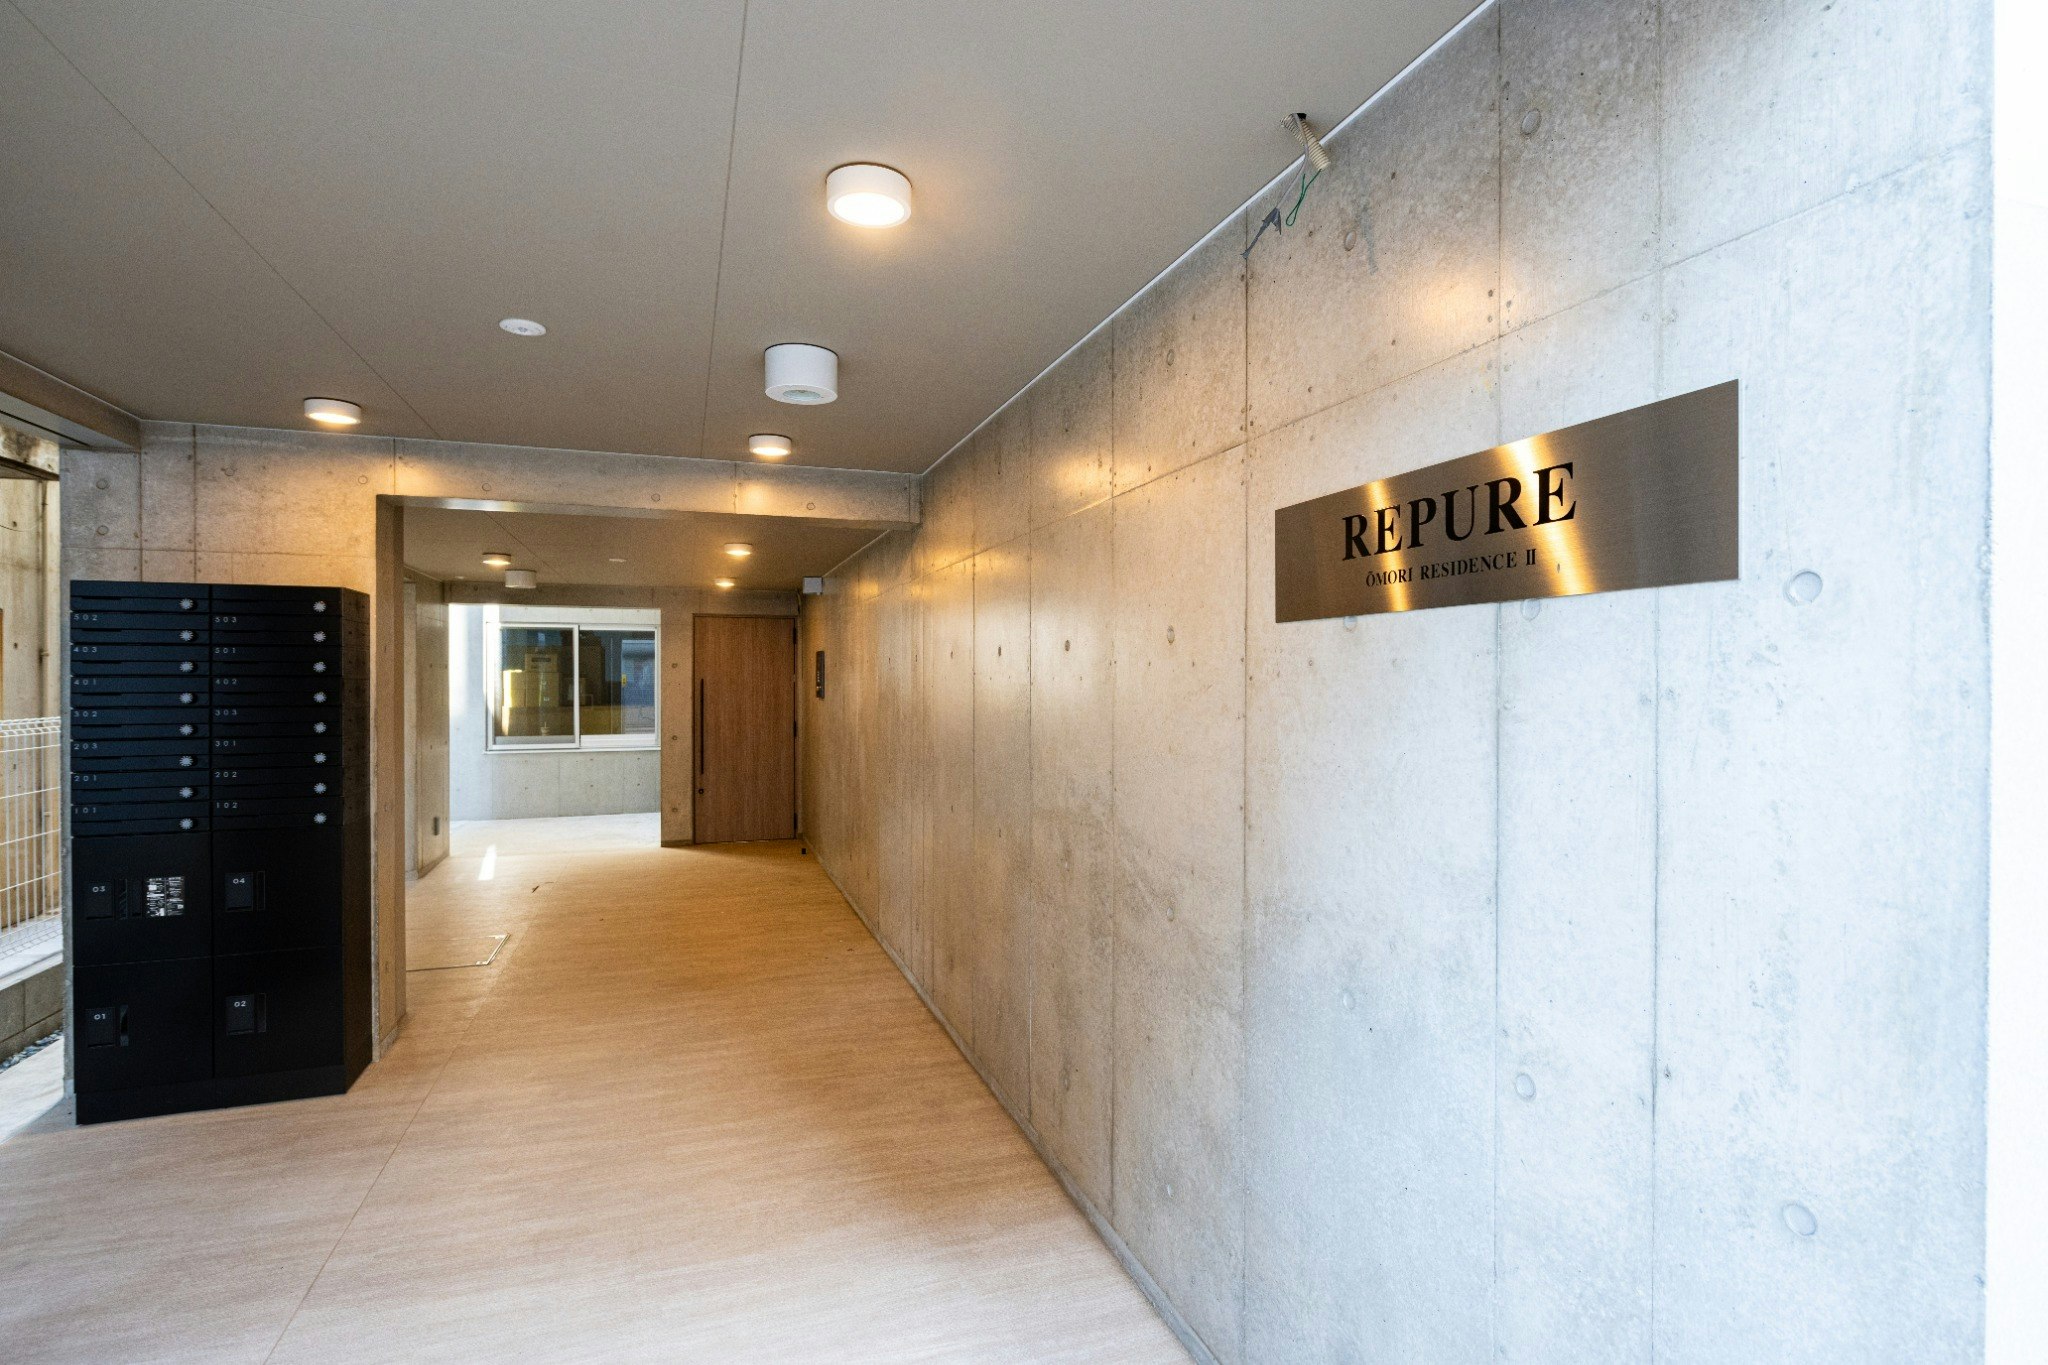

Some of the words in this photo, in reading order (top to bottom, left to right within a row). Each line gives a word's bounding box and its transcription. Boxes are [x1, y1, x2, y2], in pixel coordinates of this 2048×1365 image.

[1342, 462, 1577, 561] REPURE
[1420, 552, 1517, 580] RESIDENCE
[73, 774, 97, 782] 201
[233, 1000, 247, 1008] 02
[93, 1013, 107, 1021] 01
